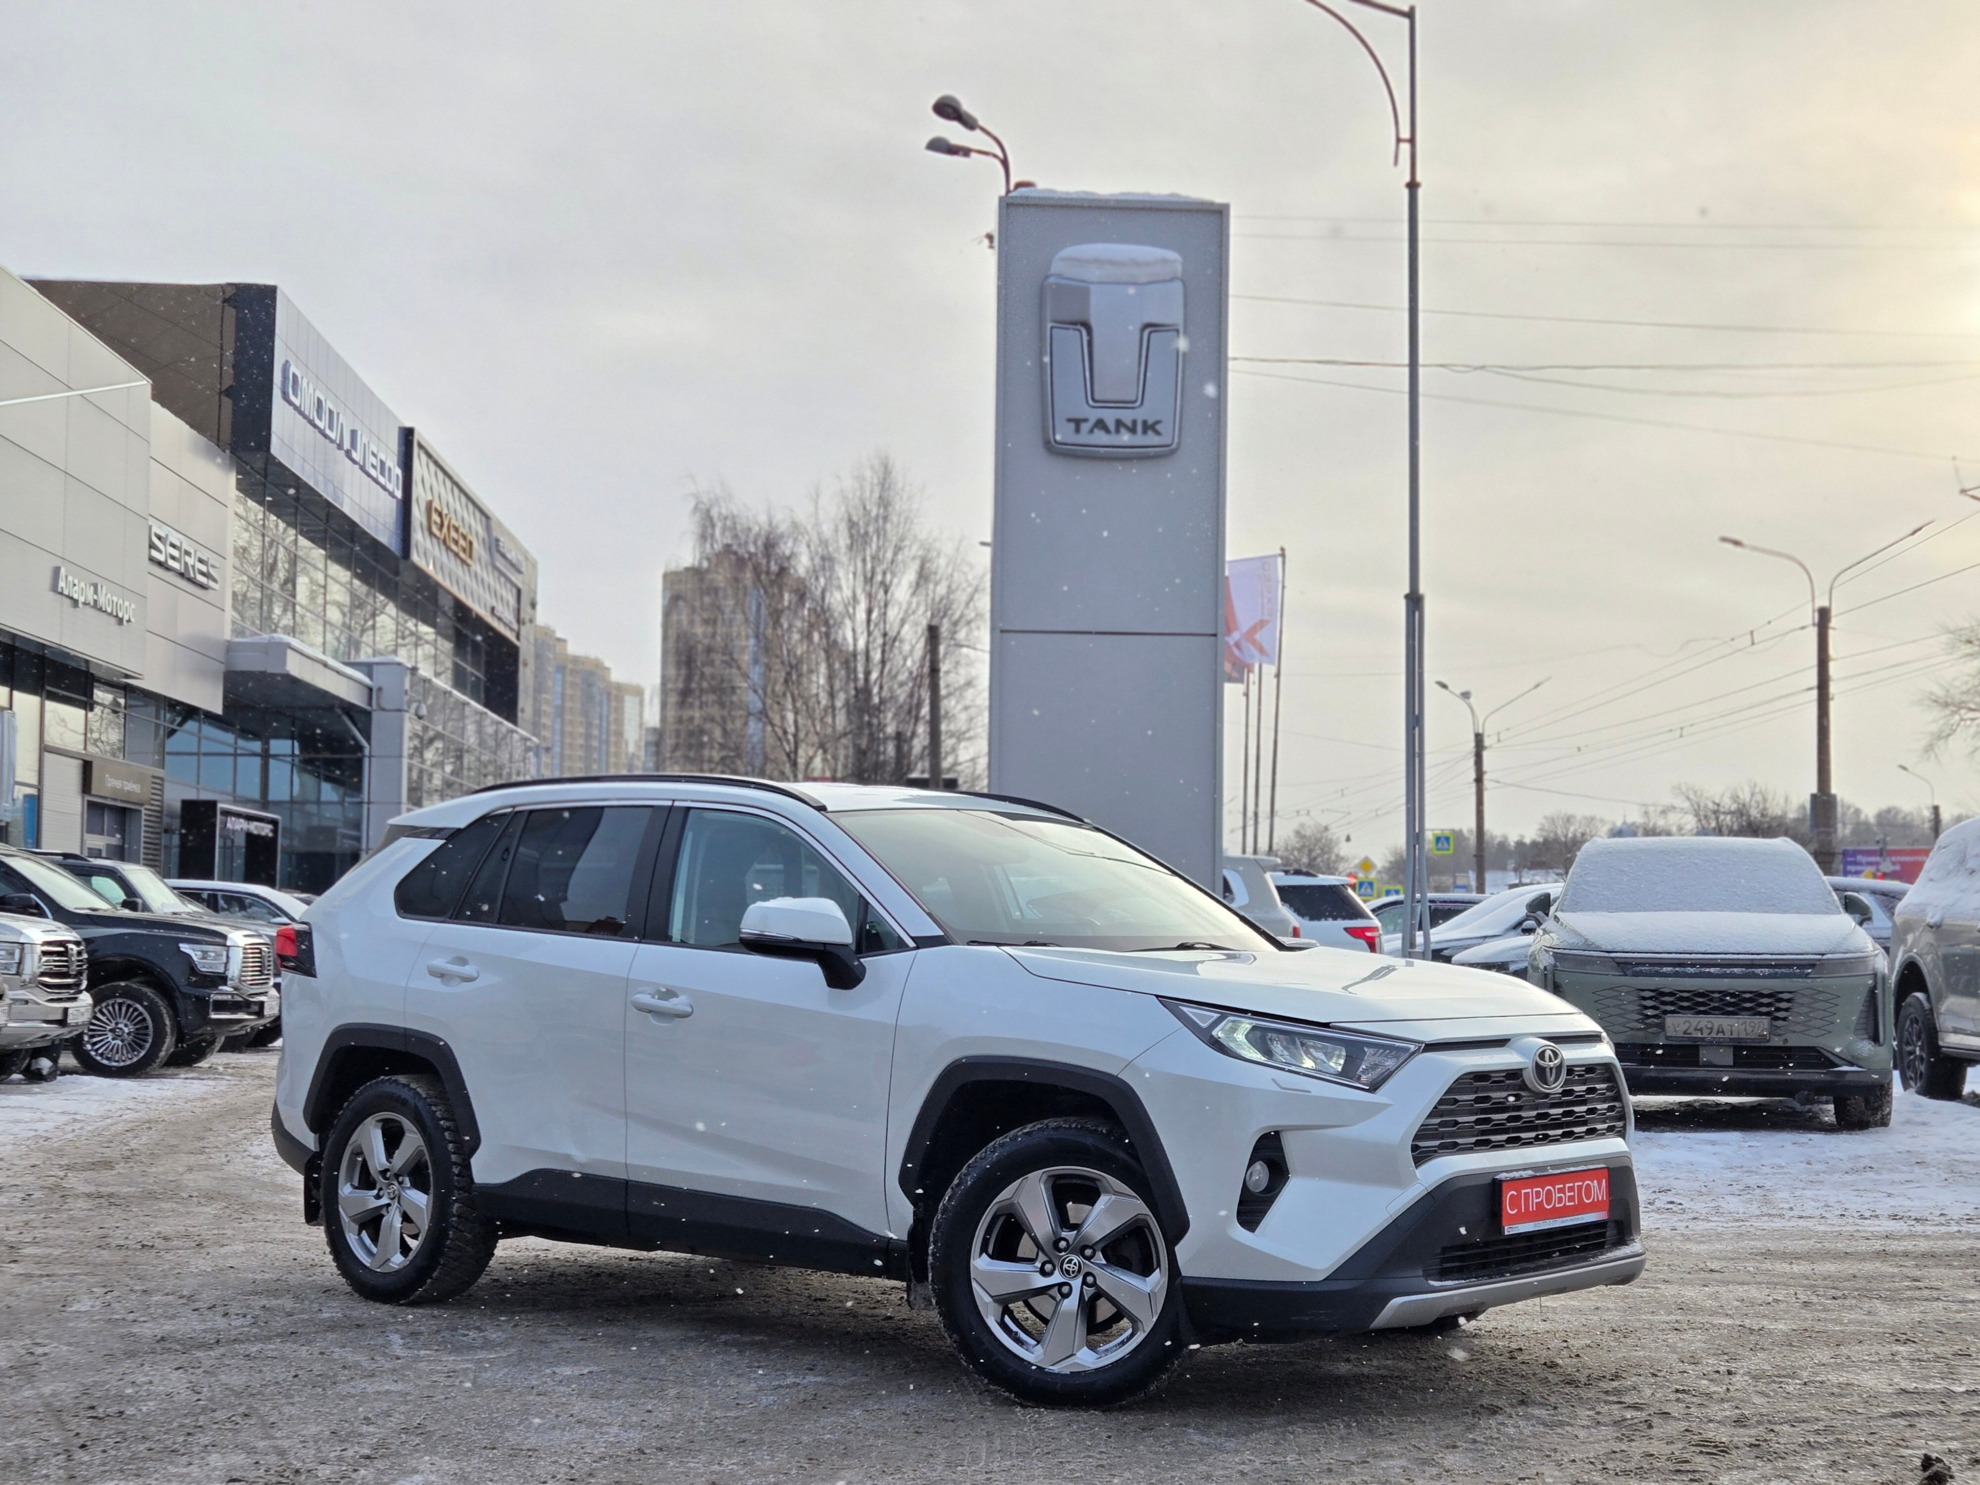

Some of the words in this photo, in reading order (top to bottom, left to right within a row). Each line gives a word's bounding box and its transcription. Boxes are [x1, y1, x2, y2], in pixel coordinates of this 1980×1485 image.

[1065, 417, 1163, 437] TANK
[149, 524, 219, 591] SERES
[428, 499, 475, 567] EXEED
[56, 565, 136, 626] Аларм-Моторс
[1506, 1190, 1518, 1215] С
[1521, 1178, 1607, 1213] ПРОБЕГОМ
